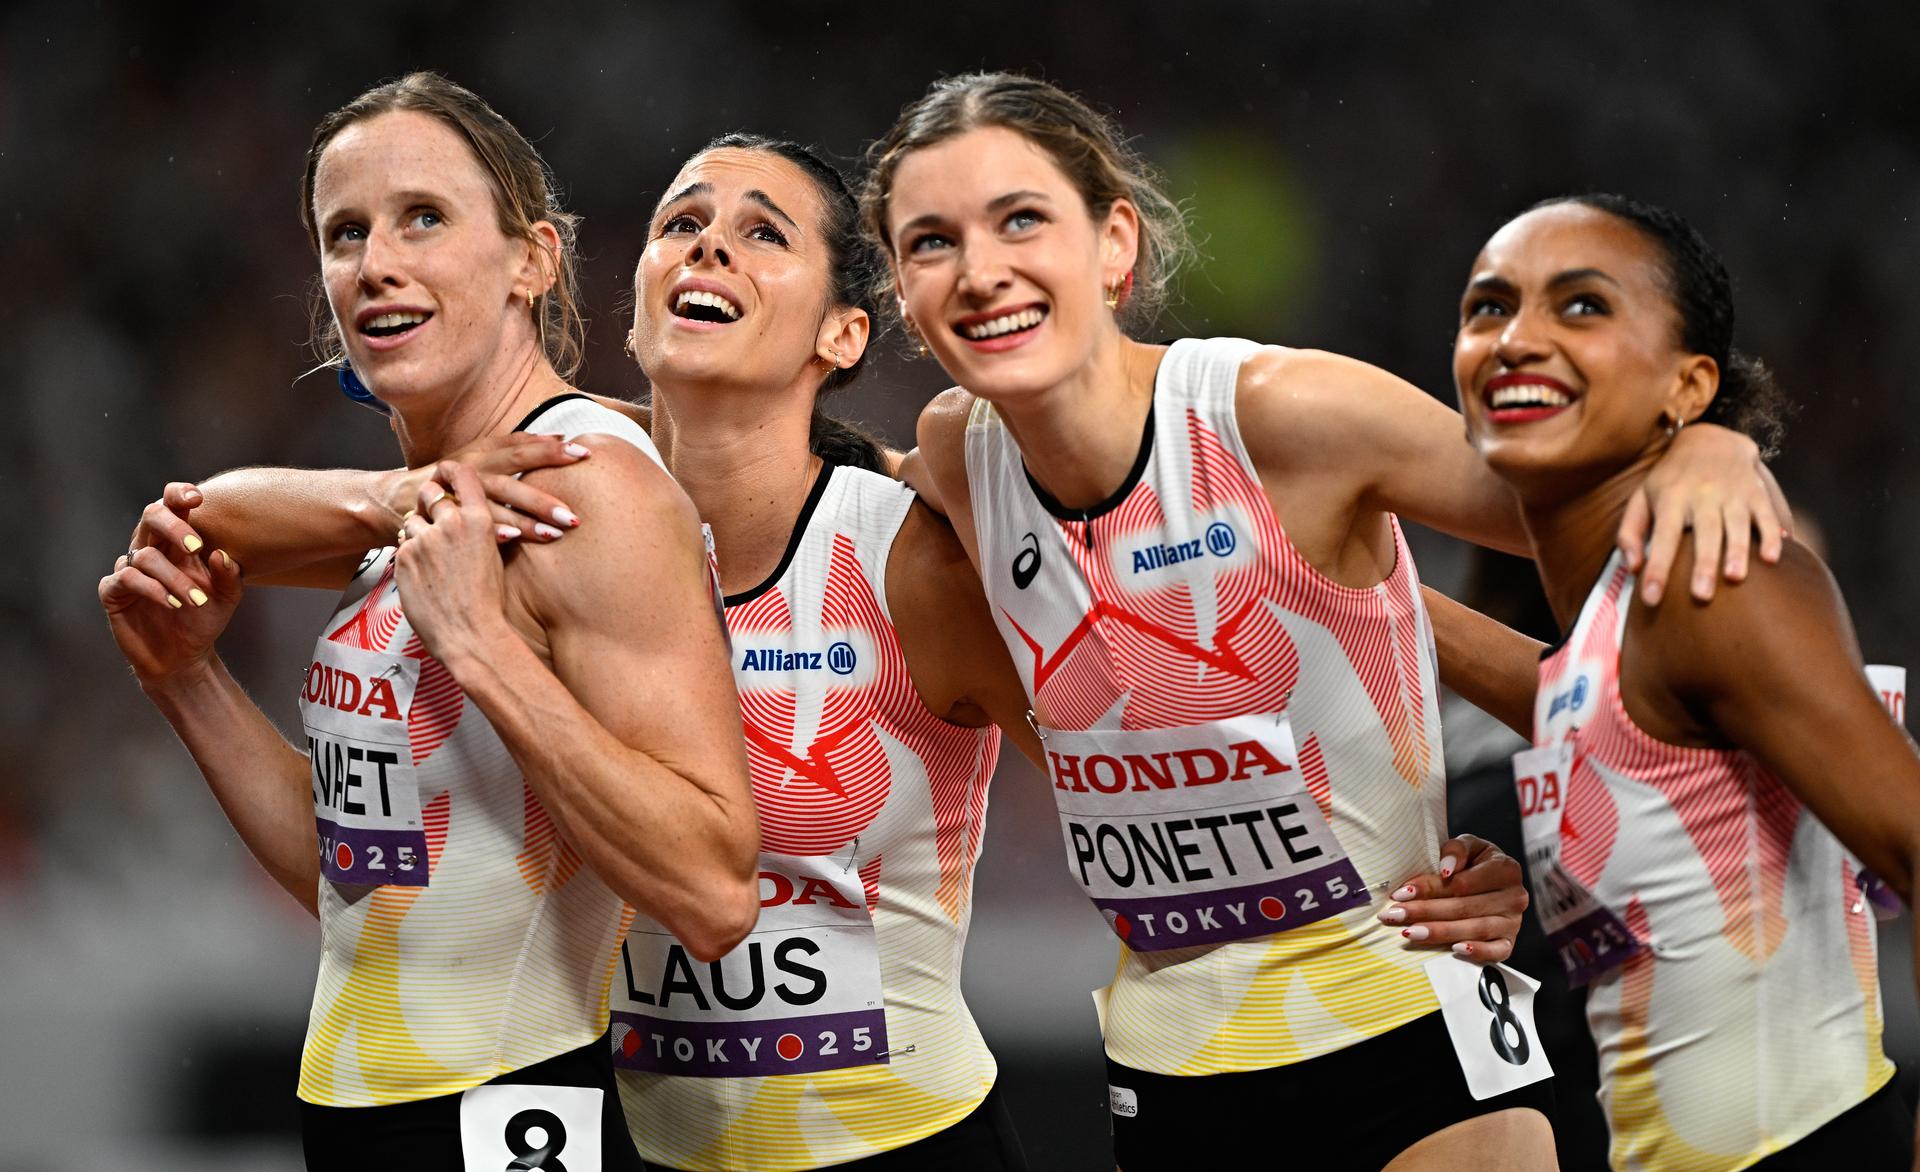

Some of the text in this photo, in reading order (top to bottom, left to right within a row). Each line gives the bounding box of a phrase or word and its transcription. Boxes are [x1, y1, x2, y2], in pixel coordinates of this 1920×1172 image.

[1132, 539, 1204, 574] Allianz
[741, 649, 822, 671] Allianz
[302, 661, 403, 720] ONDA
[308, 736, 398, 817] VAET
[1048, 740, 1293, 794] HONDA
[366, 846, 416, 871] 25
[1069, 803, 1324, 888] PONETTE
[1295, 876, 1349, 911] 25
[622, 937, 827, 1011] LAUS
[818, 1027, 872, 1055] 25
[1479, 965, 1530, 1065] 8
[505, 1109, 567, 1172] 8
